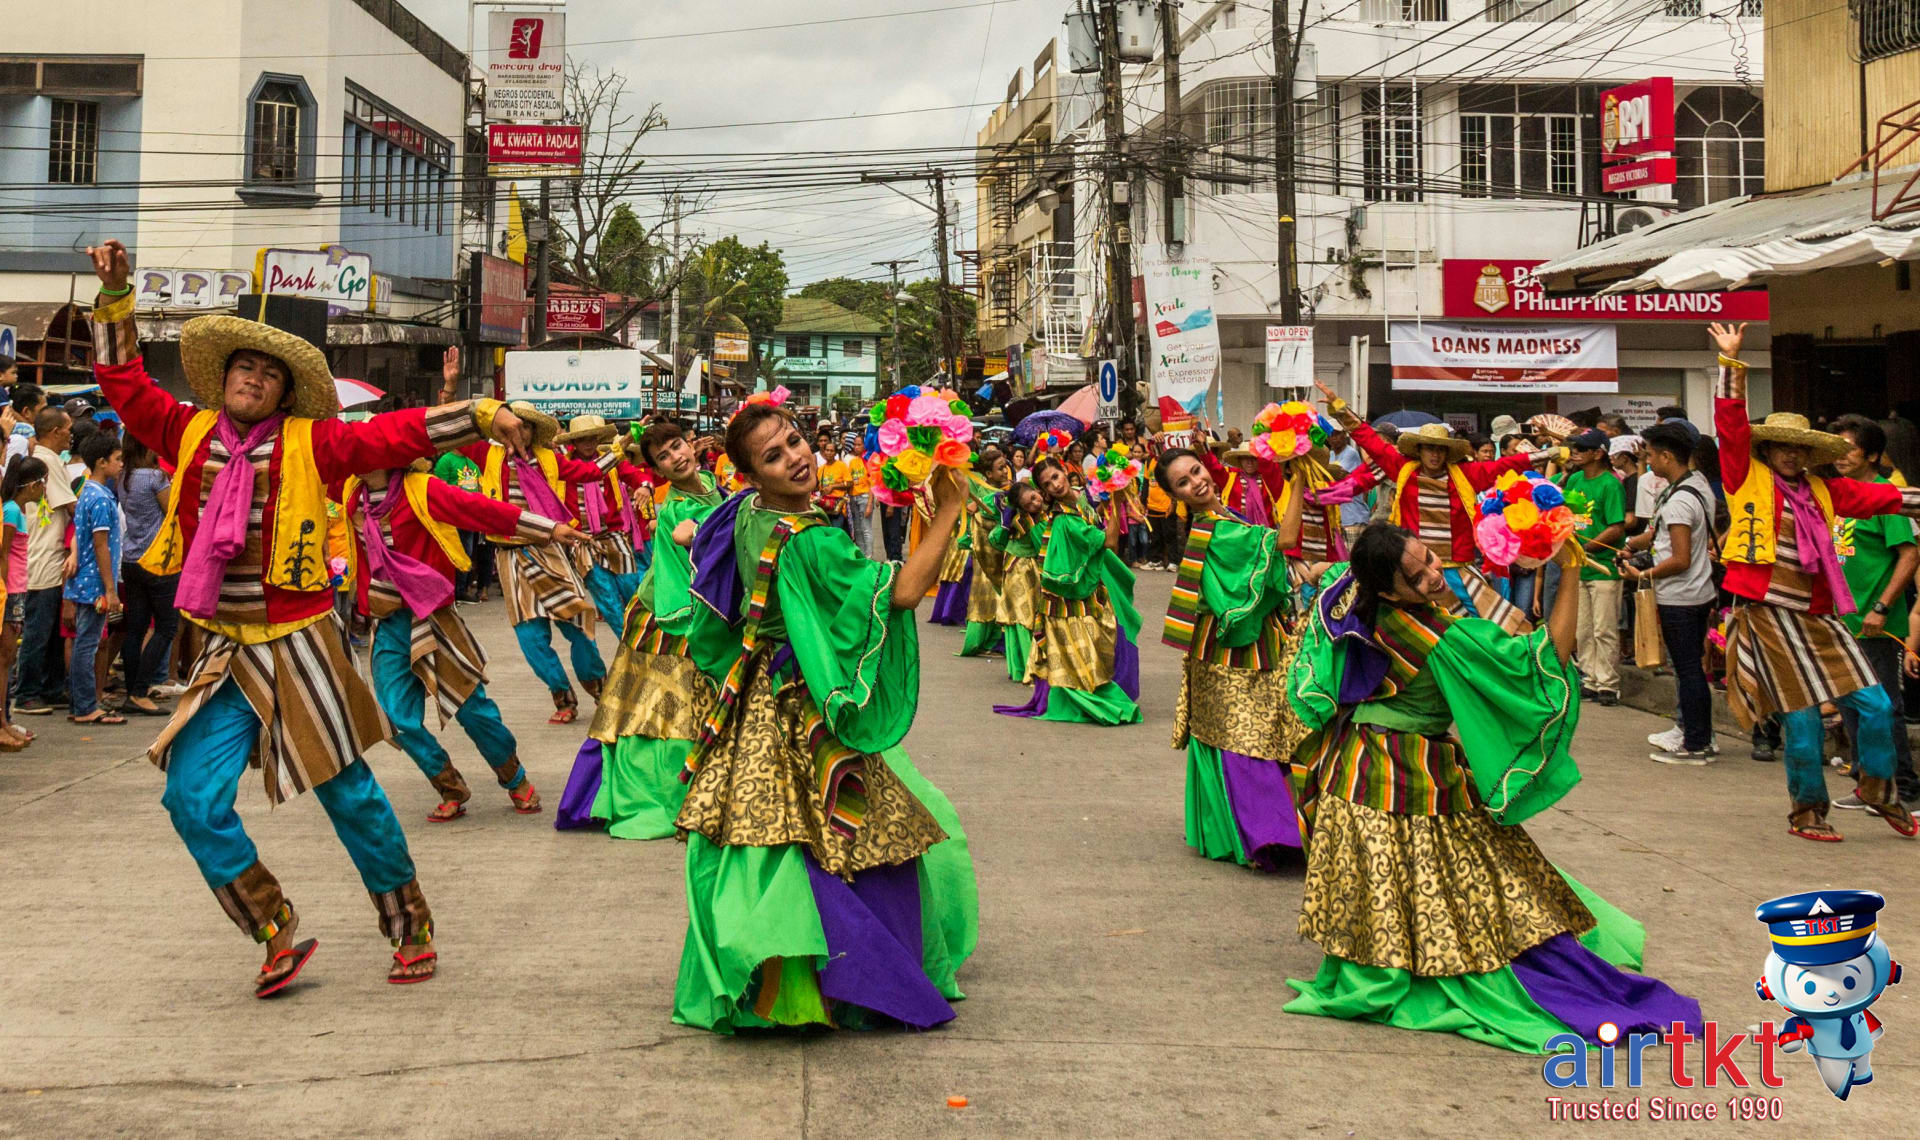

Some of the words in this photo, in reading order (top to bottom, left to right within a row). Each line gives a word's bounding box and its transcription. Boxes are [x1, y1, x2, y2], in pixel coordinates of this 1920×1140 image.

[490, 63, 534, 72] mercury
[538, 62, 562, 72] drug
[493, 89, 518, 99] NEGROS
[519, 89, 555, 100] OCCIDENTAL
[488, 100, 518, 109] VICTORIAS
[519, 100, 532, 109] CITY
[533, 101, 561, 110] ASCALON
[1619, 95, 1649, 145] BPI
[493, 132, 505, 147] ML
[508, 132, 543, 148] KWARTA
[545, 133, 579, 149] PADALA
[269, 264, 316, 289] Park
[338, 265, 367, 300] Go
[547, 299, 601, 314] RBEE'S
[1635, 293, 1723, 313] ISLANDS
[1267, 328, 1286, 337] NOW
[1288, 327, 1309, 336] OPEN
[1431, 336, 1491, 354] LOANS
[1496, 338, 1582, 355] MADNESS
[1193, 354, 1214, 362] Card
[520, 373, 611, 392] TODABA
[616, 373, 630, 391] 9
[1170, 376, 1207, 385] Victorias
